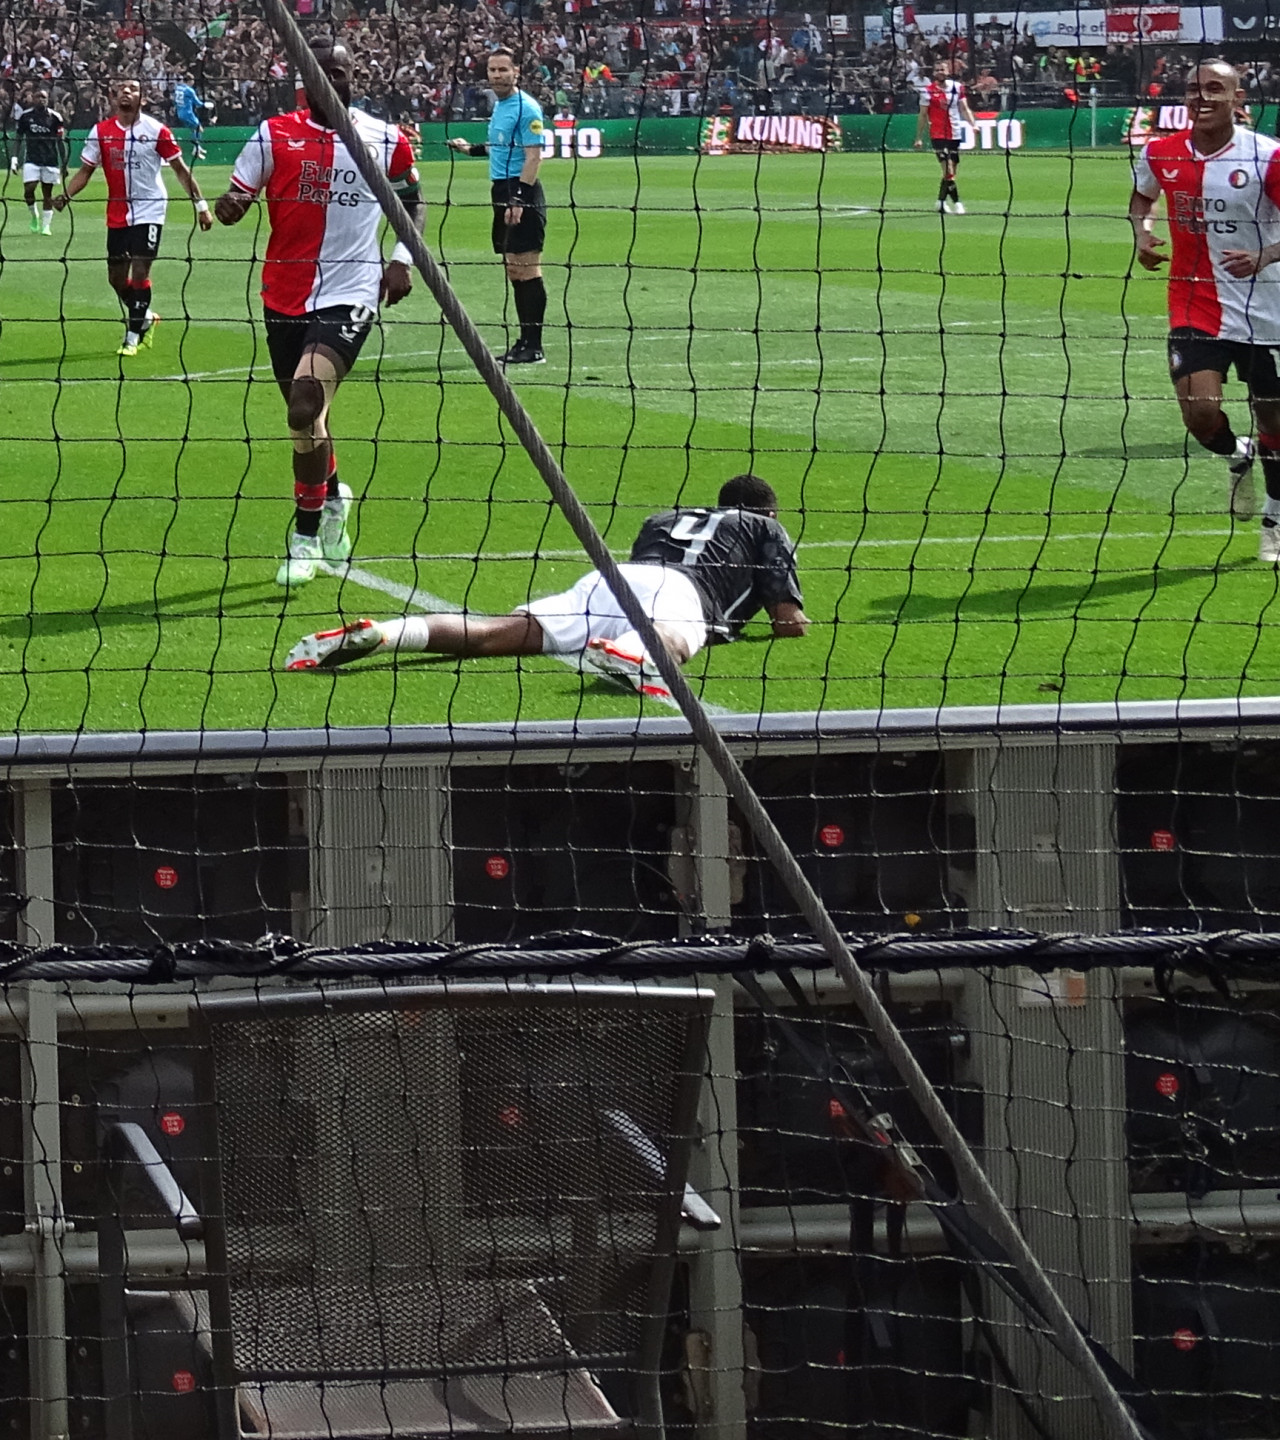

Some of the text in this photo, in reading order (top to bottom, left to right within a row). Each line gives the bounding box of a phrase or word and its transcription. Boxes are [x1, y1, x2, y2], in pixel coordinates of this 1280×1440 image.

[541, 128, 601, 158] OTO
[737, 116, 824, 150] KONING
[959, 119, 1022, 150] OTO
[299, 160, 356, 185] Euro
[297, 183, 360, 207] Parcs
